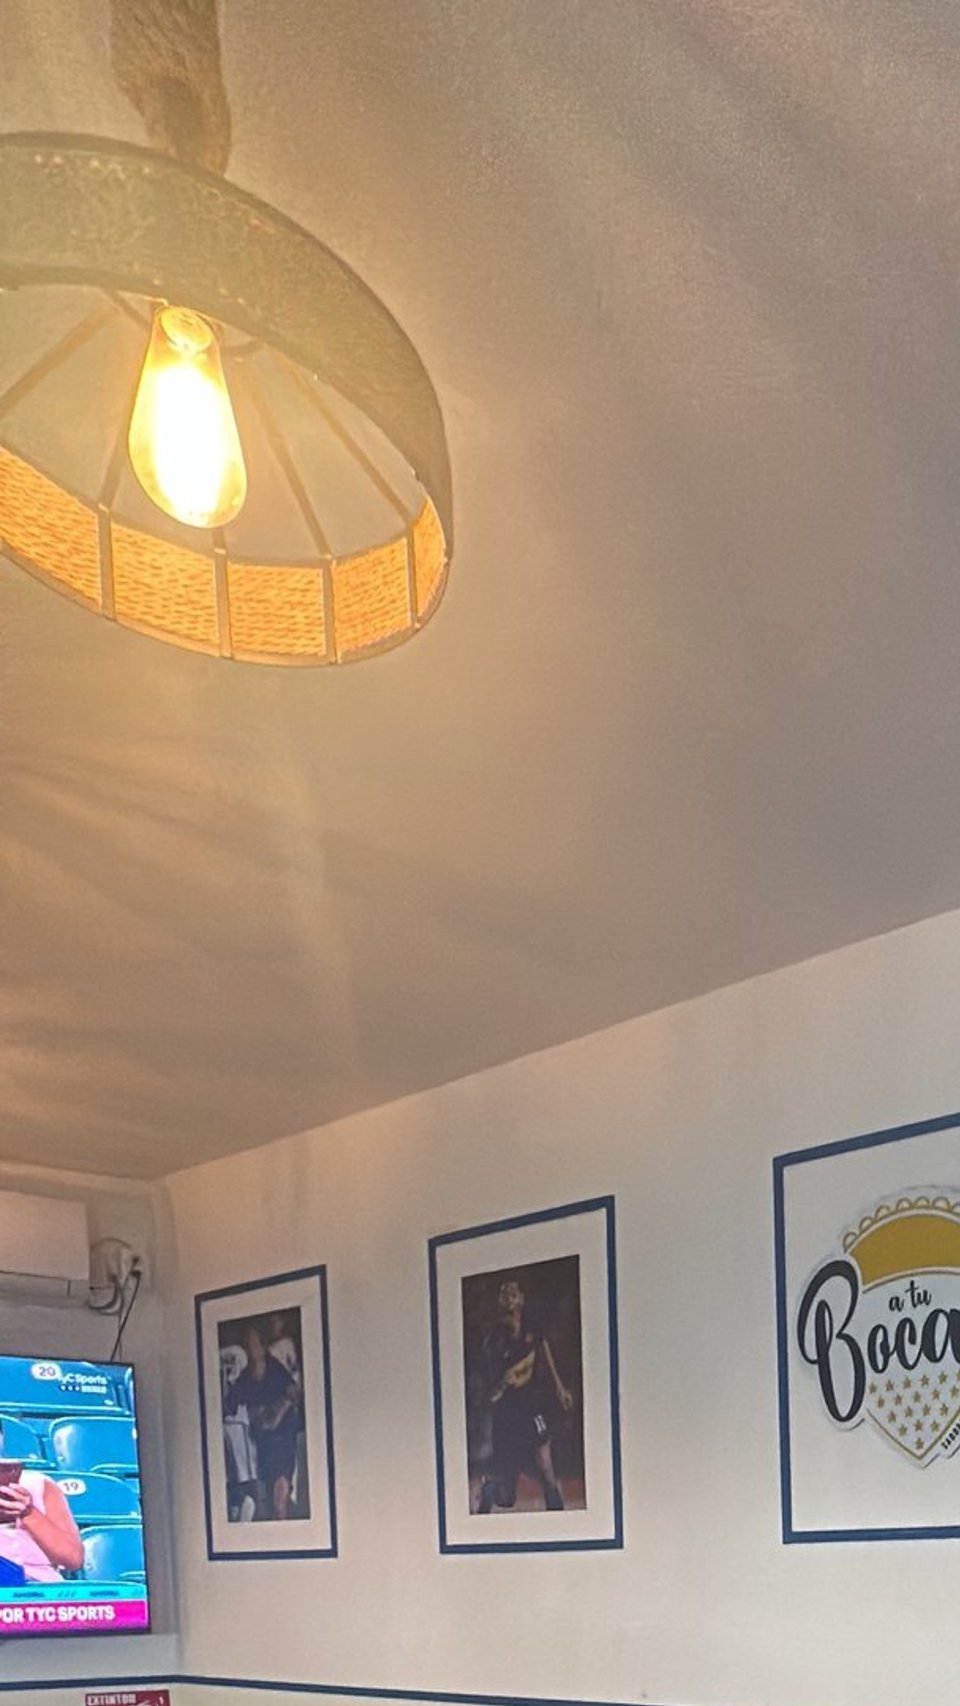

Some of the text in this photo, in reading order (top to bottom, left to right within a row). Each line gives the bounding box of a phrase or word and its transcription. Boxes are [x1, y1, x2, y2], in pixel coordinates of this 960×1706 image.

[888, 1279, 933, 1313] a tu
[25, 1606, 57, 1622] TYC
[57, 1604, 116, 1622] SPORTS
